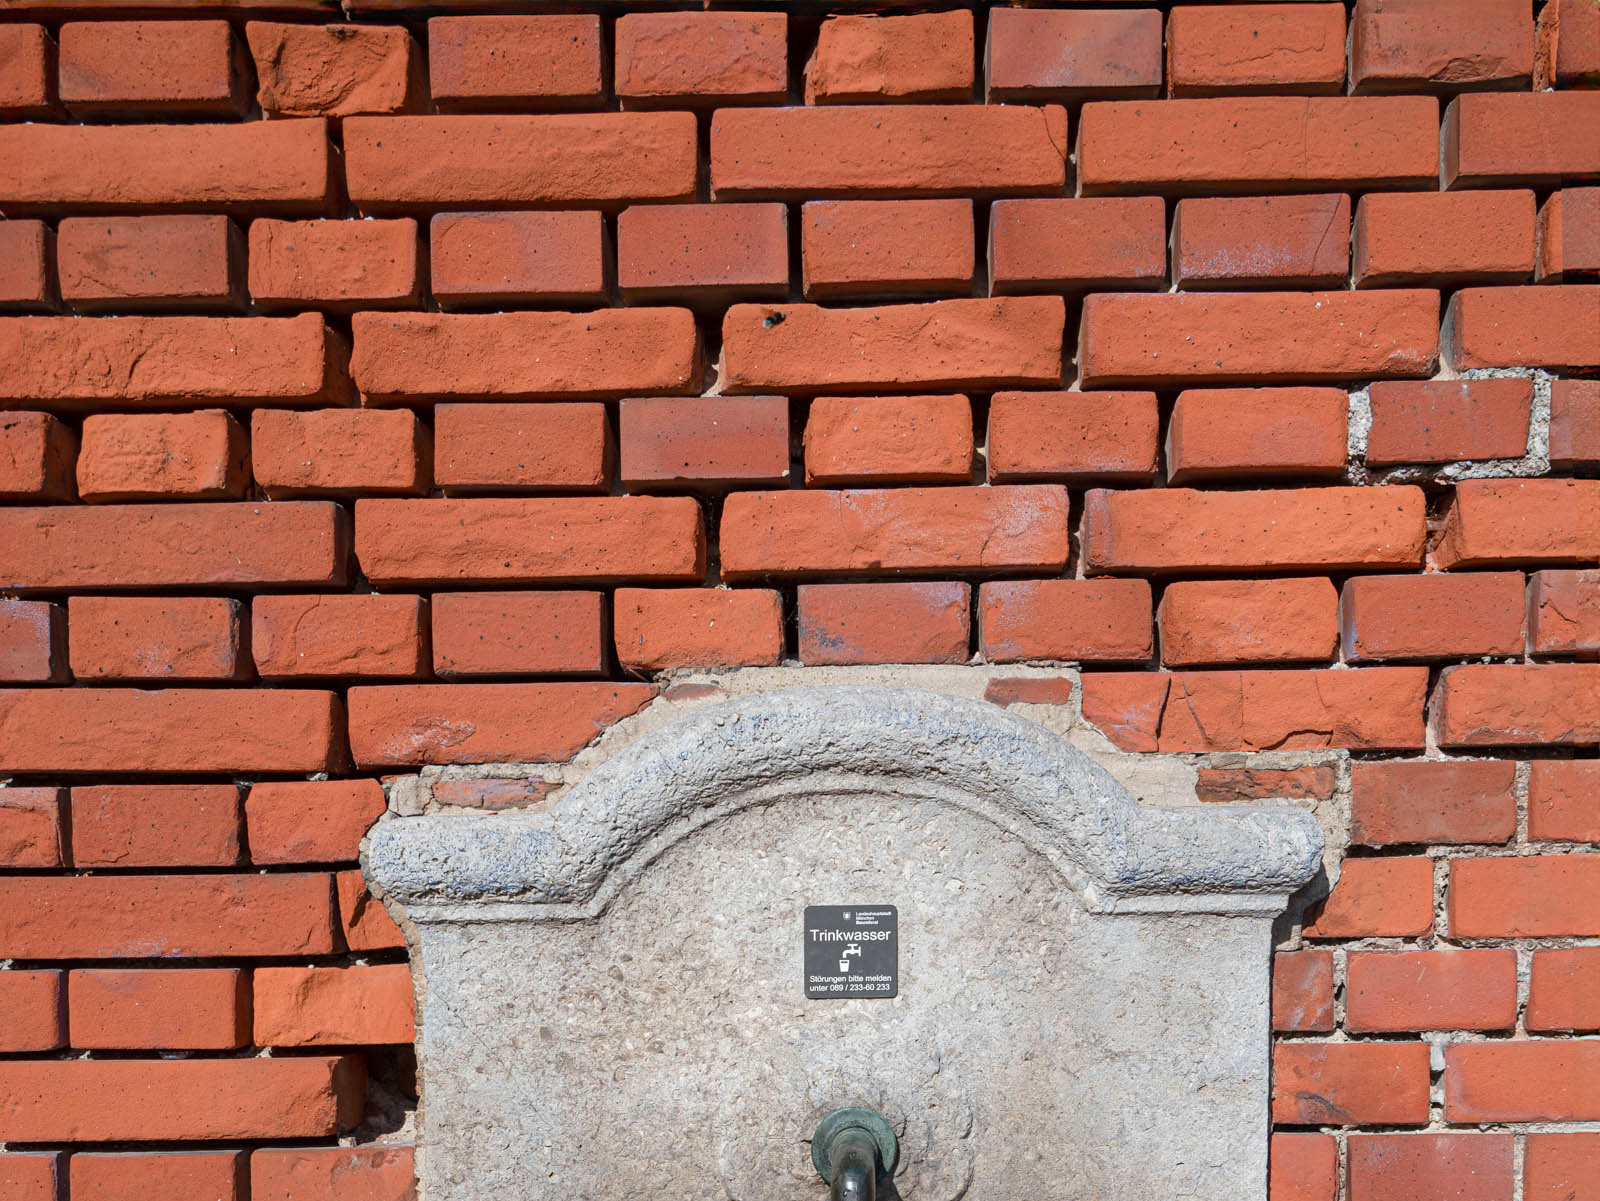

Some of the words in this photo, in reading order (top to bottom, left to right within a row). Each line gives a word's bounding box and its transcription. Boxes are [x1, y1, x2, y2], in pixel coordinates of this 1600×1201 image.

[809, 929, 892, 942] Trinkwasser
[809, 975, 847, 984] Störungen
[865, 974, 892, 982] melden
